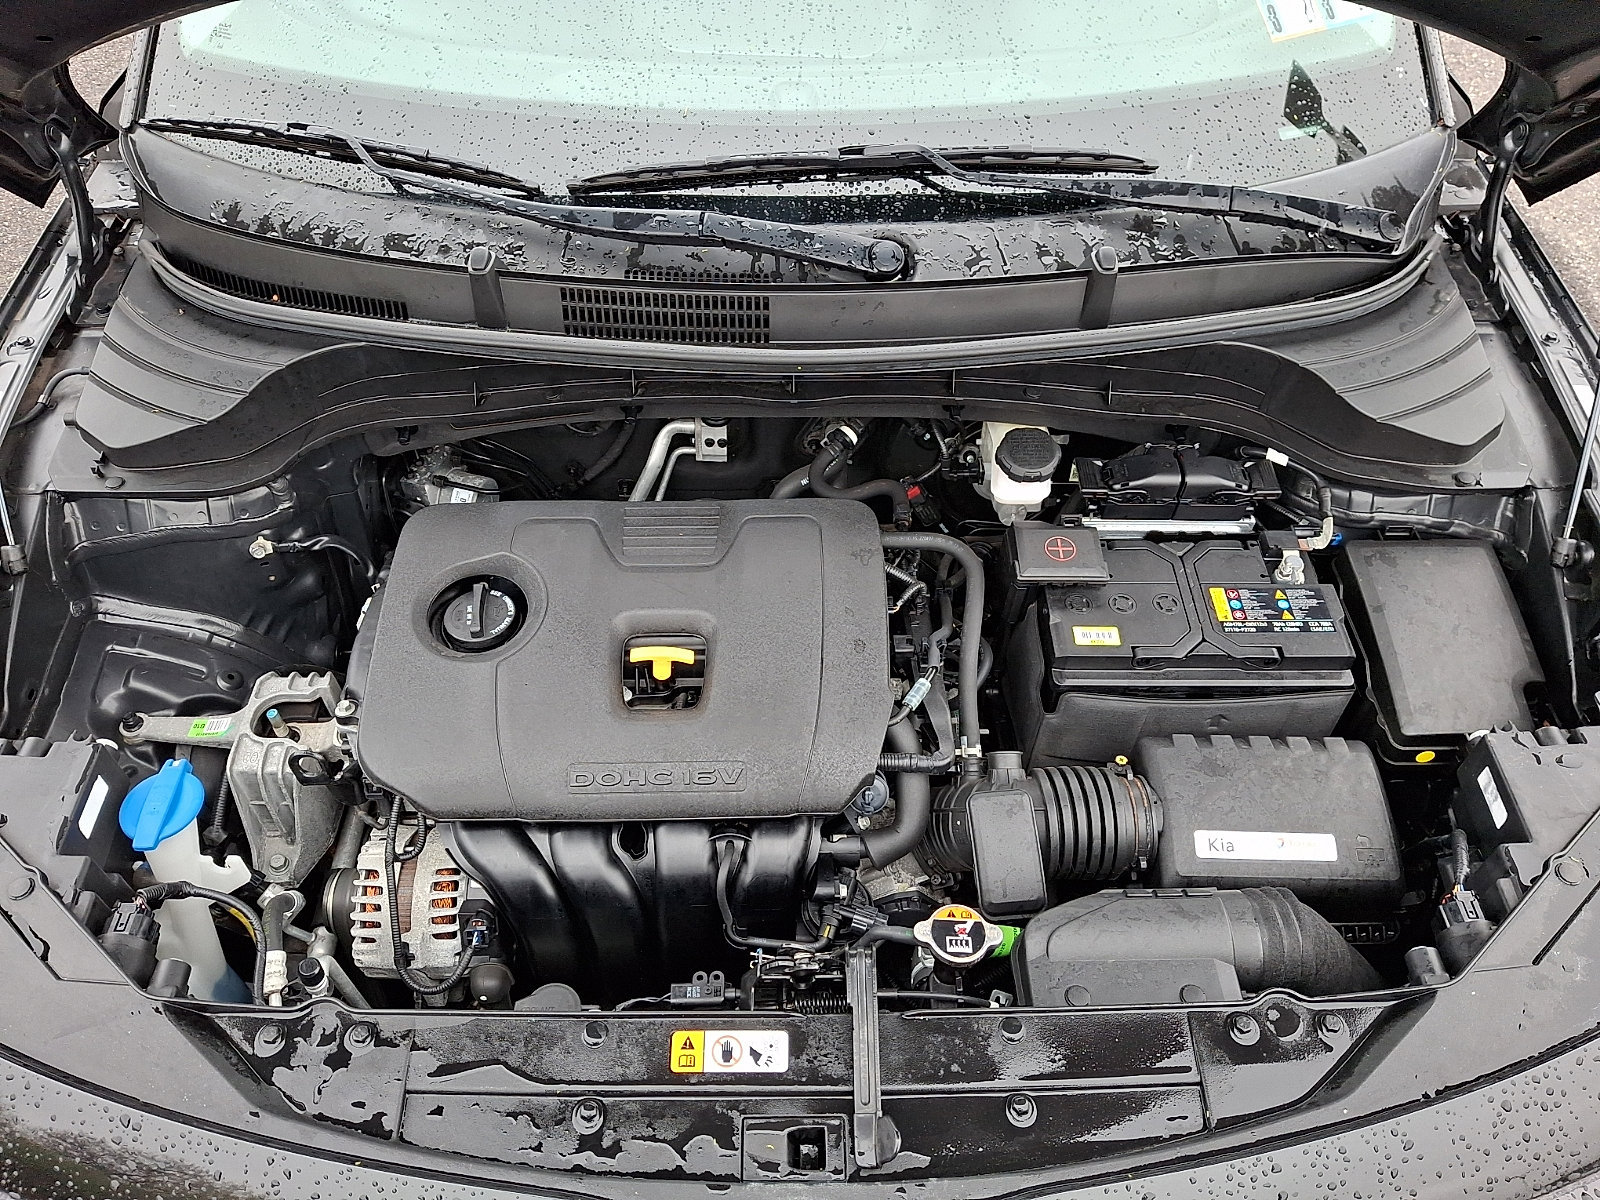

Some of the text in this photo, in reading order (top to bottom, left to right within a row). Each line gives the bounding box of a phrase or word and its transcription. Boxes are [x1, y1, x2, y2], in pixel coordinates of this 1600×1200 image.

[569, 767, 744, 788] DOHC 16V
[1208, 838, 1235, 853] Kia
